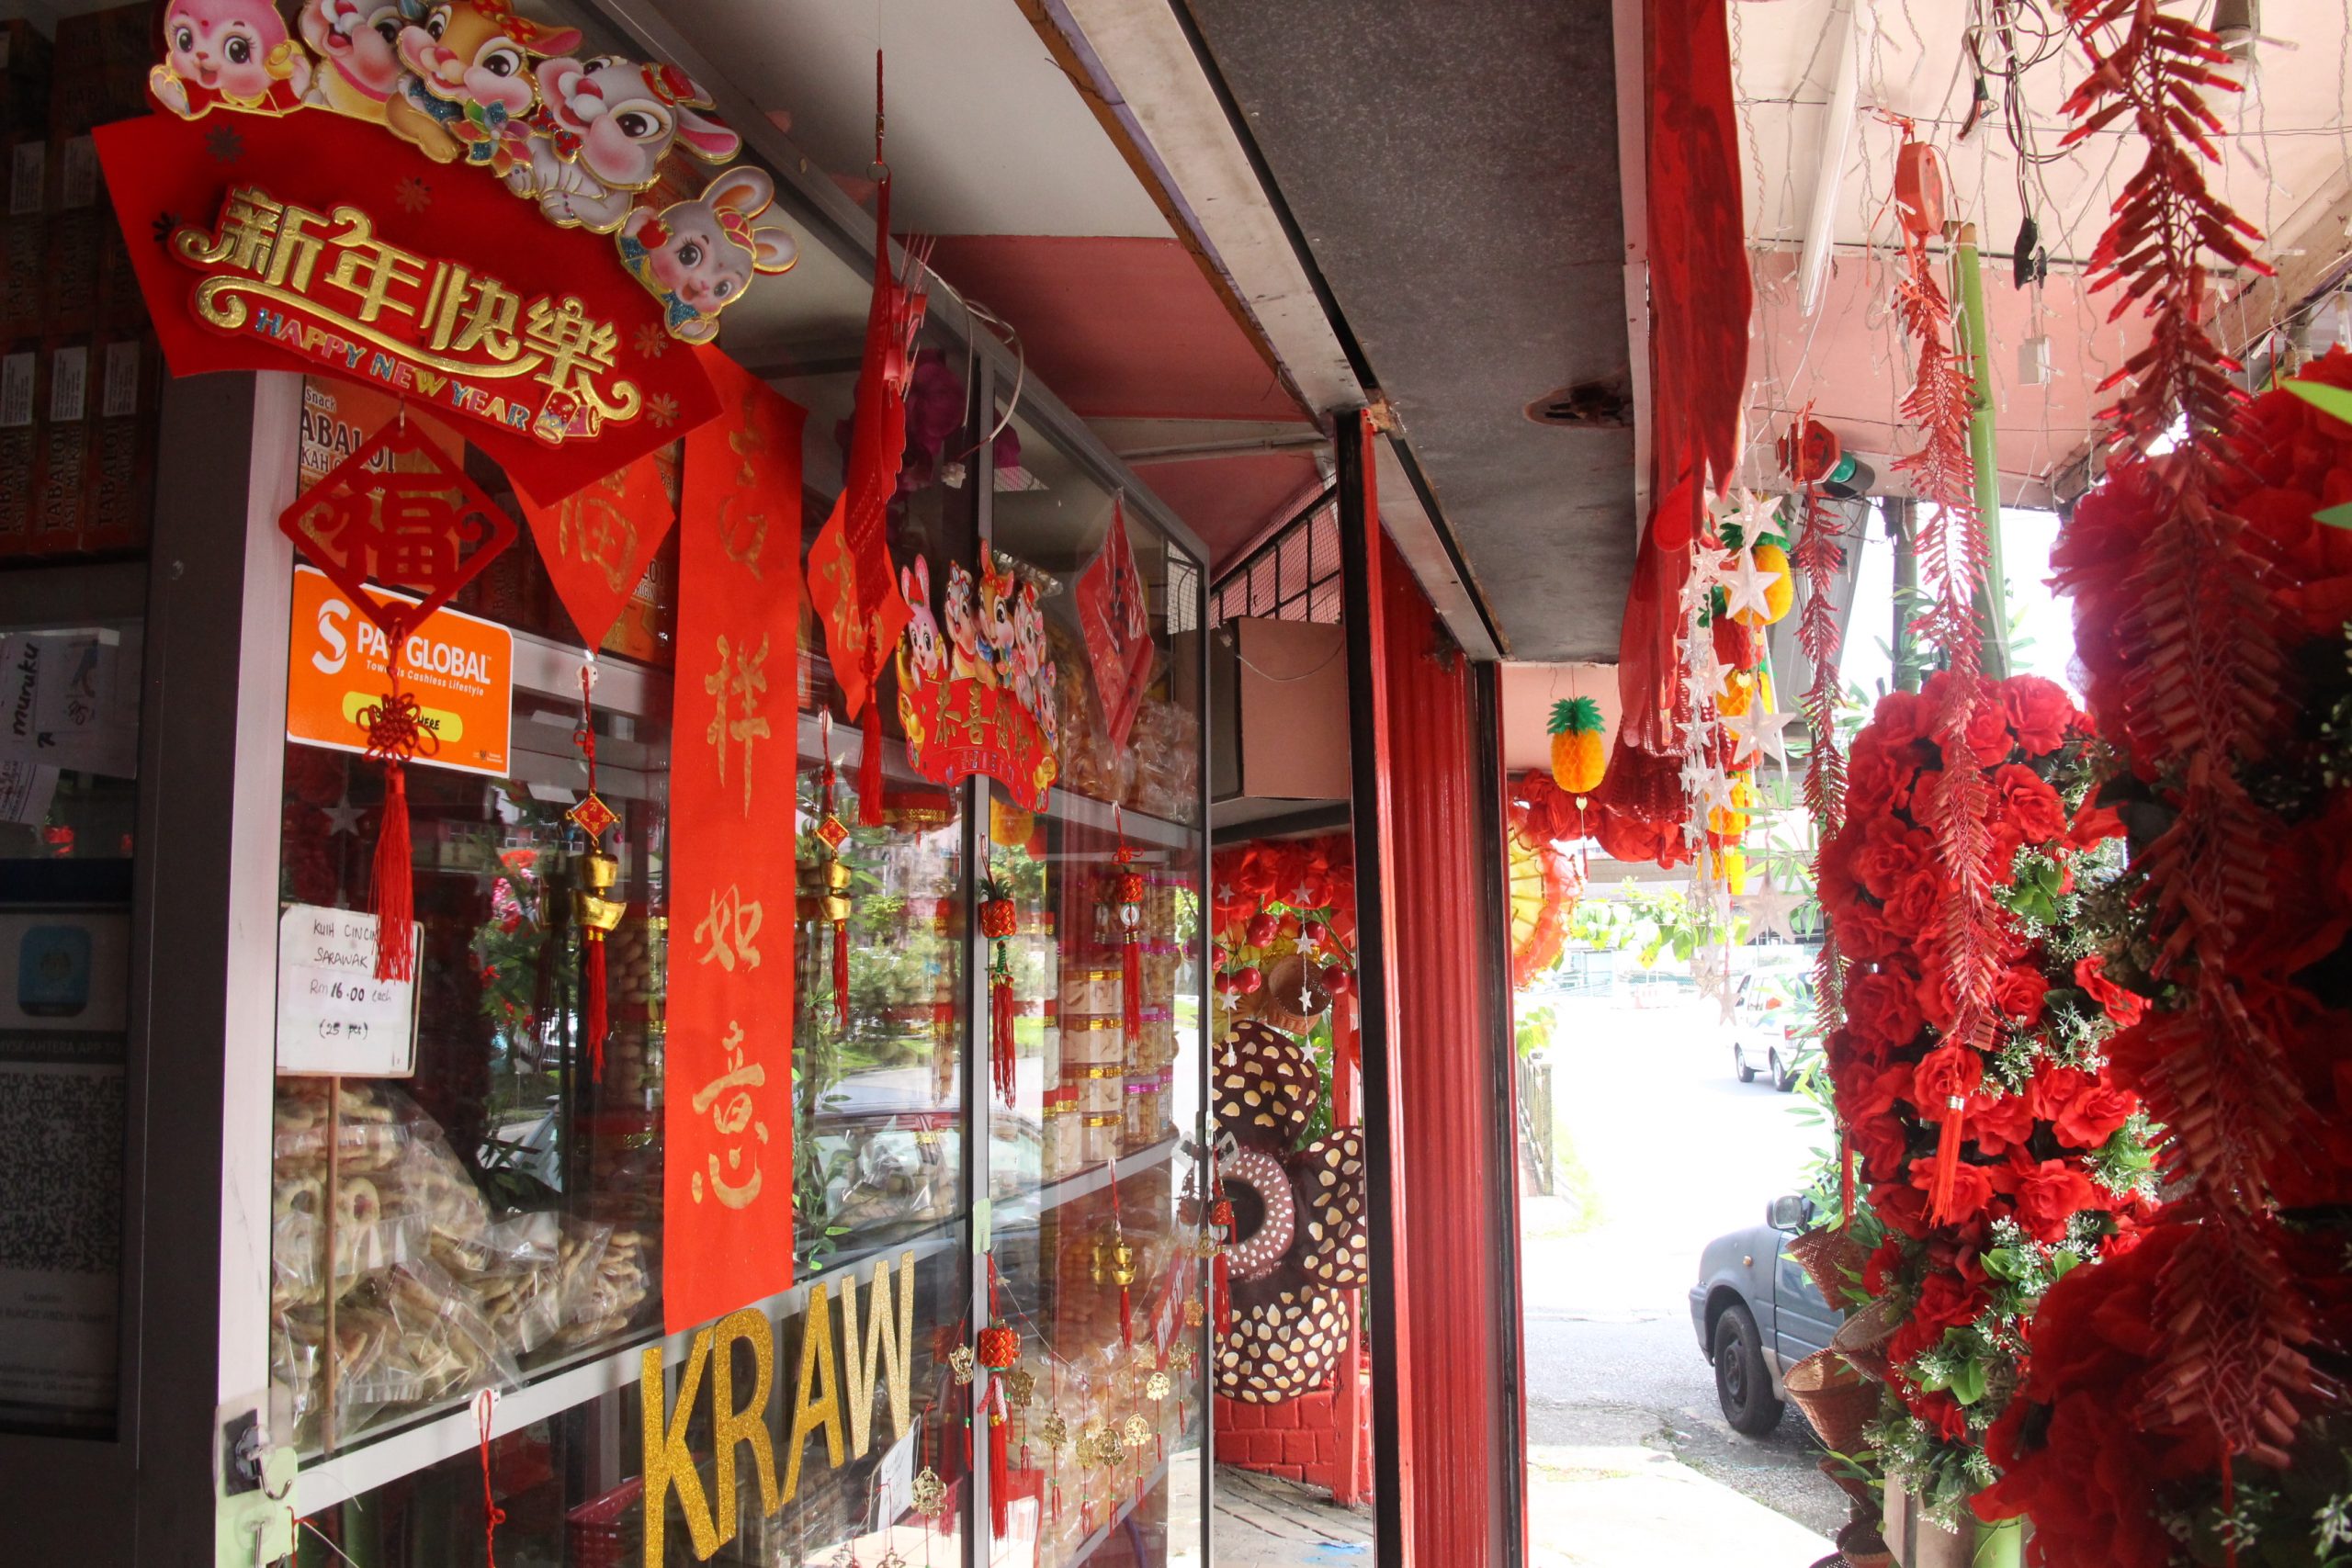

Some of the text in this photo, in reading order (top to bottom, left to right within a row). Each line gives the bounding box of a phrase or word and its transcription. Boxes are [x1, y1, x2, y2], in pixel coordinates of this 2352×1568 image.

[176, 186, 640, 419] 新年快樂
[254, 308, 530, 431] HAPPY NEW YEAR
[305, 388, 336, 412] Snack
[356, 621, 395, 660] PA
[406, 636, 492, 684] GLOBAL
[407, 669, 447, 687] Cashless
[448, 679, 484, 696] Lifestyle
[313, 919, 334, 939] KUIH
[314, 947, 368, 968] SARAWAK
[640, 1249, 915, 1568] KRAW
